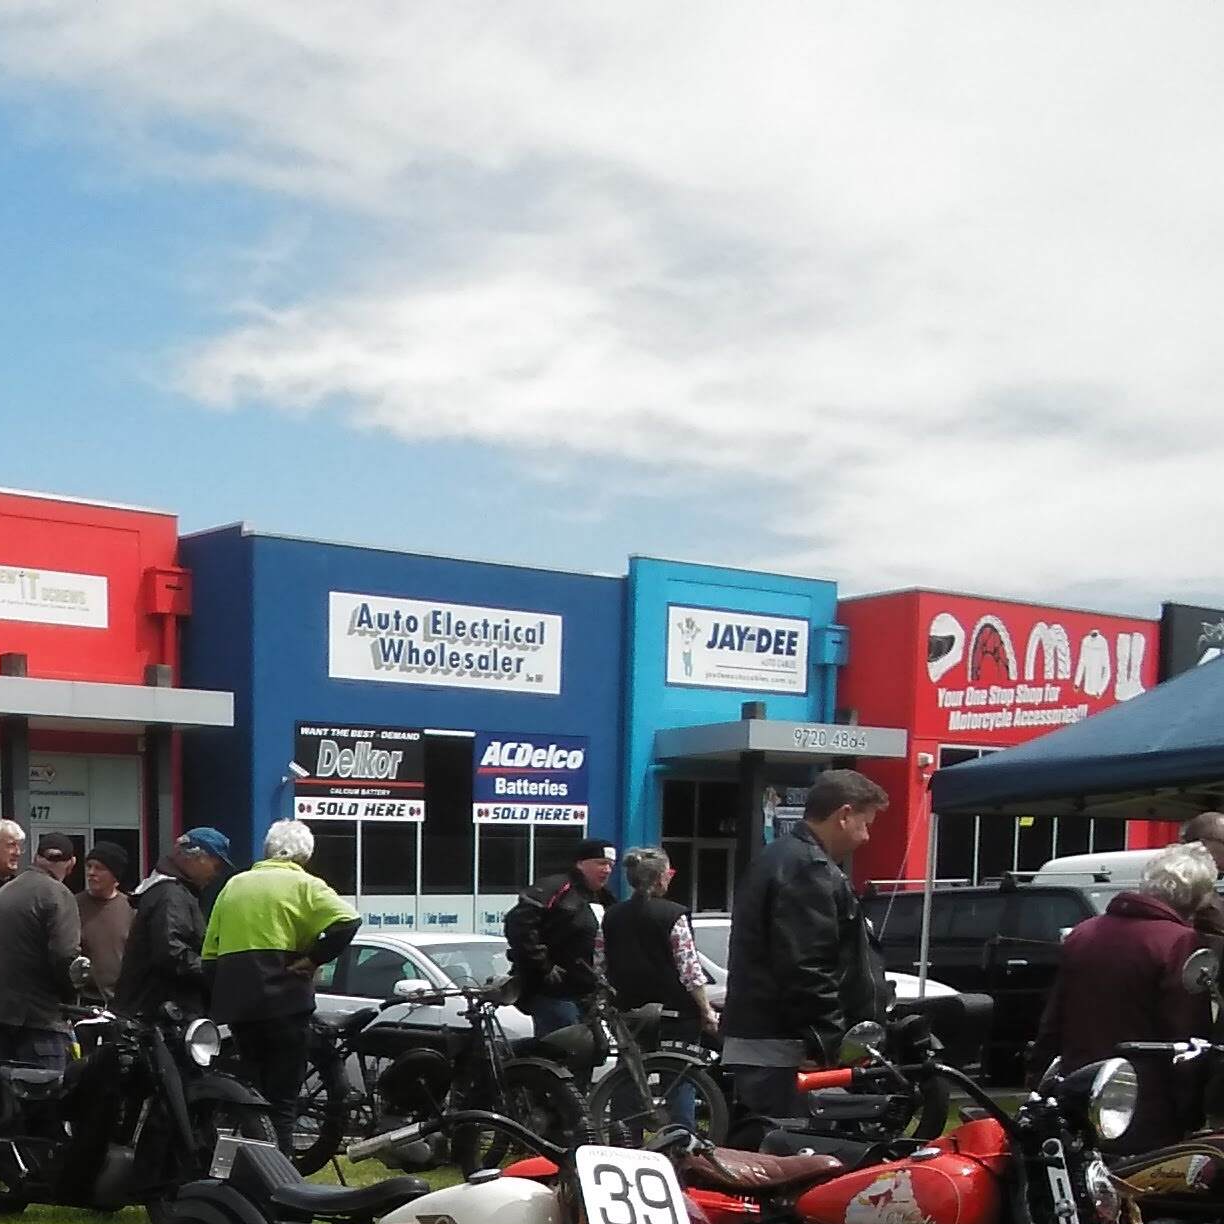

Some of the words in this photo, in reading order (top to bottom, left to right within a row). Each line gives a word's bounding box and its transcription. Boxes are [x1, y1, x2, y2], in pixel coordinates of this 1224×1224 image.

[356, 602, 418, 634] Auto
[431, 610, 545, 645] Electrical
[706, 622, 798, 656] JAY-DEE
[379, 637, 525, 674] Wholesaler
[949, 708, 1012, 731] Motorcycle
[301, 727, 330, 736] WANT
[331, 728, 349, 737] THE
[351, 730, 375, 738] BEST
[381, 731, 420, 740] DEMAND
[794, 728, 826, 748] 9720
[316, 739, 403, 779] Delkor
[480, 741, 584, 769] ACDelco
[495, 777, 568, 796] Batteries
[30, 806, 50, 819] 477
[316, 802, 359, 815] SOLD
[364, 803, 406, 816] HERE
[491, 807, 529, 819] SOLD
[534, 808, 571, 820] HERE
